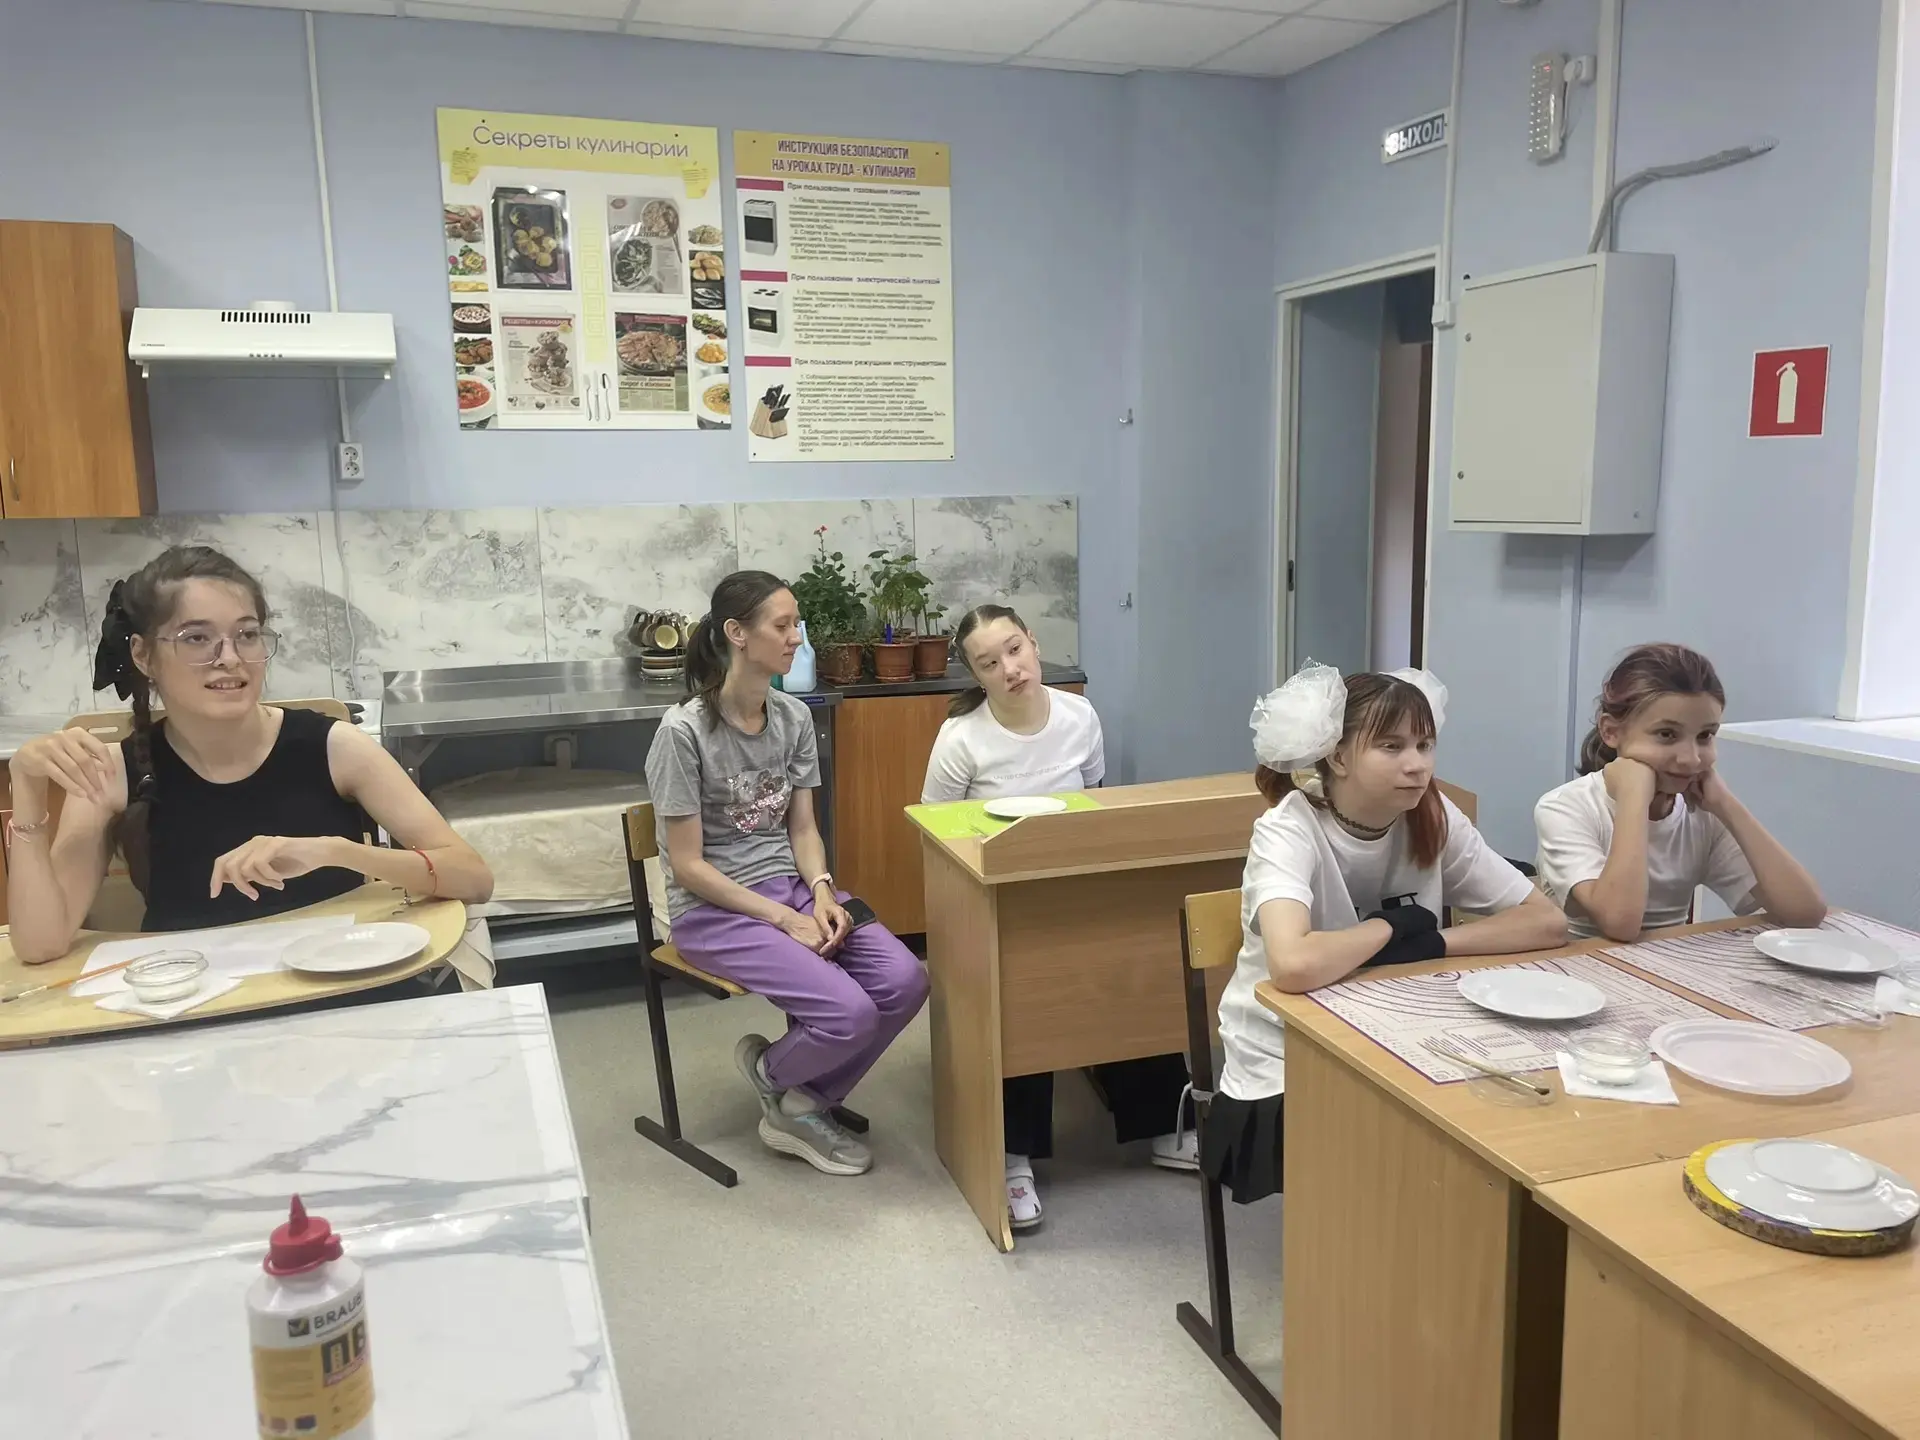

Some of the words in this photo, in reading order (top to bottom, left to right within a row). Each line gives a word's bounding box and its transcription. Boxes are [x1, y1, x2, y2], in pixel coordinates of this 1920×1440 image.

[472, 125, 570, 150] Секреты
[576, 135, 689, 159] кулинарии
[778, 140, 839, 156] ИНСТРУКЦИЯ
[840, 144, 909, 160] БЕЗОПАСНОСТИ
[772, 159, 785, 171] НА
[787, 159, 823, 173] УРОКАХ
[825, 162, 855, 176] ТРУДА
[862, 164, 916, 179] КУЛИНАРИЯ
[787, 182, 802, 191] При
[791, 273, 806, 282] При
[795, 357, 809, 366] При
